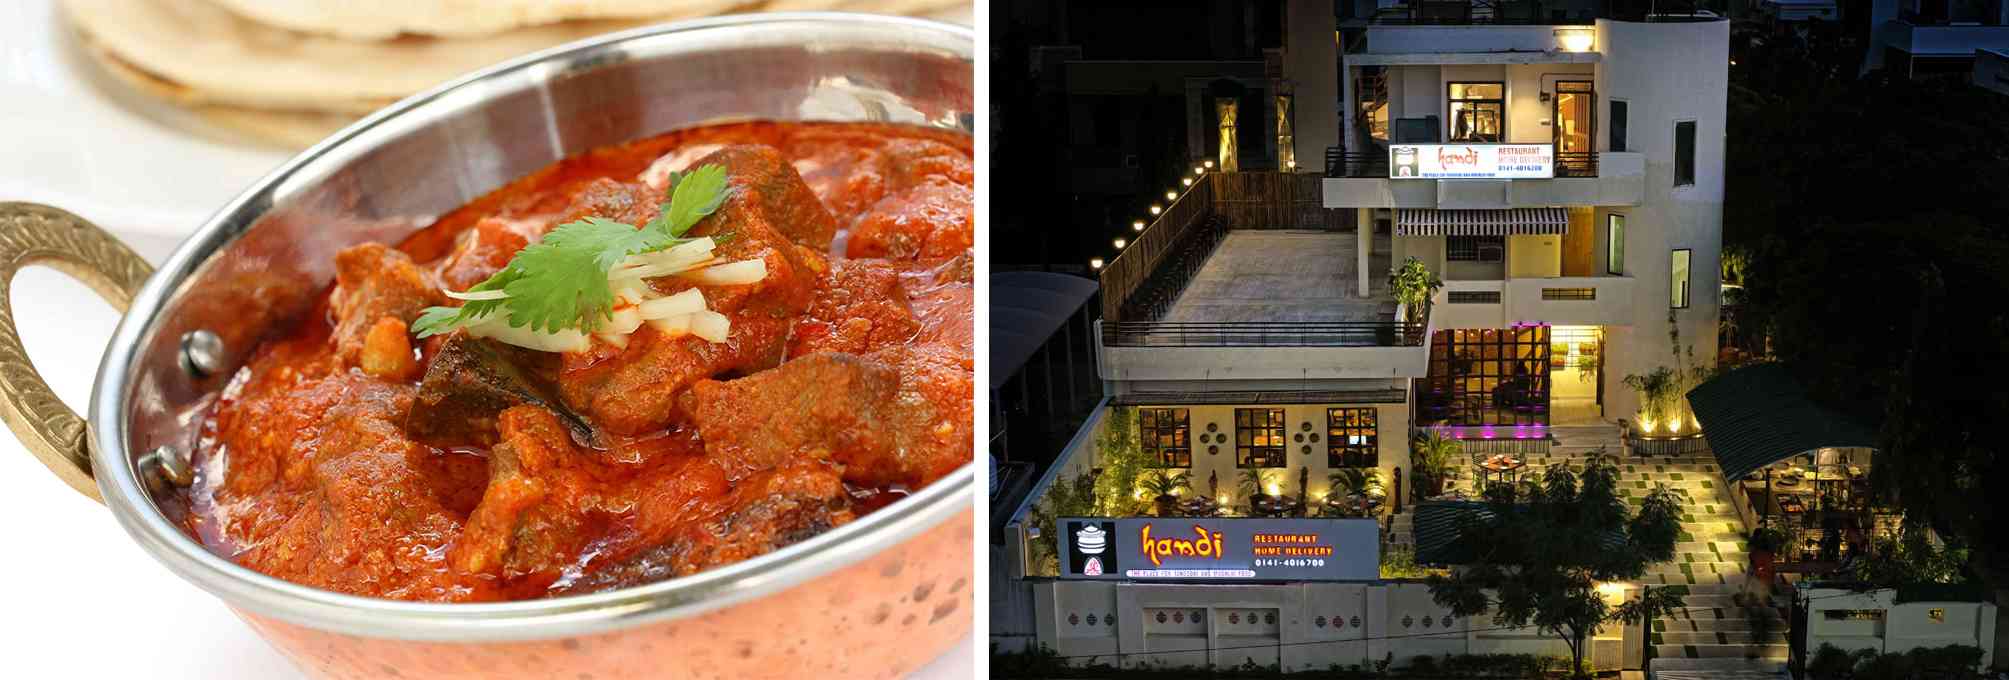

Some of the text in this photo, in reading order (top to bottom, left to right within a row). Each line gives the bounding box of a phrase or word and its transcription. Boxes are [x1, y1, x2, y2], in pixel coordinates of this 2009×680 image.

[1498, 147, 1540, 155] RESTAURANT
[1438, 146, 1478, 171] handi
[1253, 534, 1318, 543] RESTAURANT
[1141, 523, 1223, 567] handi
[1253, 546, 1333, 556] HOME DELIVERY
[1255, 559, 1324, 567] 0141-4016700
